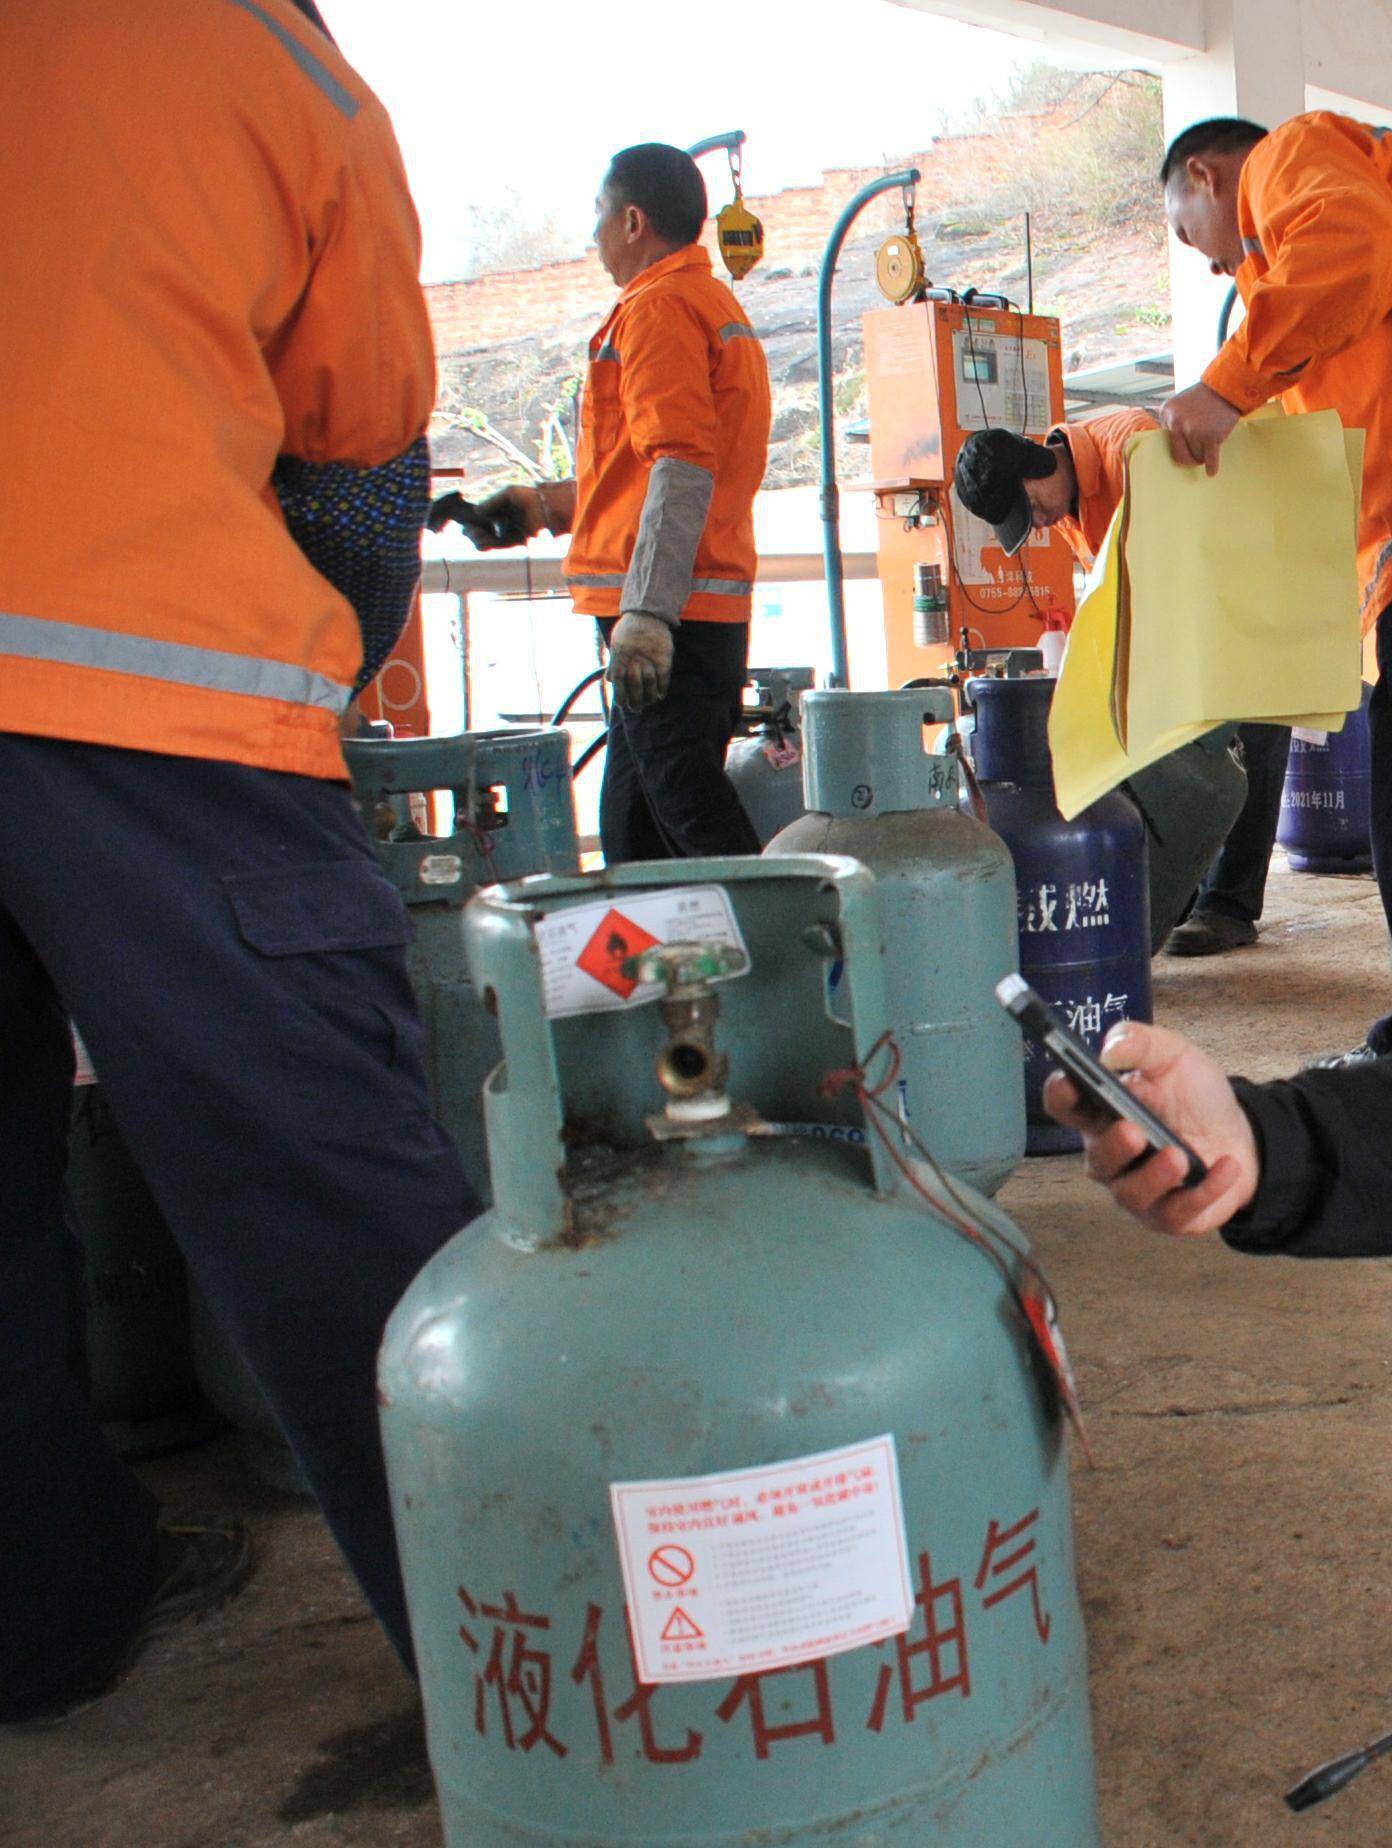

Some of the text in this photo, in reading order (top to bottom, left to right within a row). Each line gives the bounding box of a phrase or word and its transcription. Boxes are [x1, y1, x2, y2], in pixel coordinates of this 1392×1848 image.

[1049, 992, 1130, 1035] 油气
[457, 1507, 1052, 1768] 液化石油气
